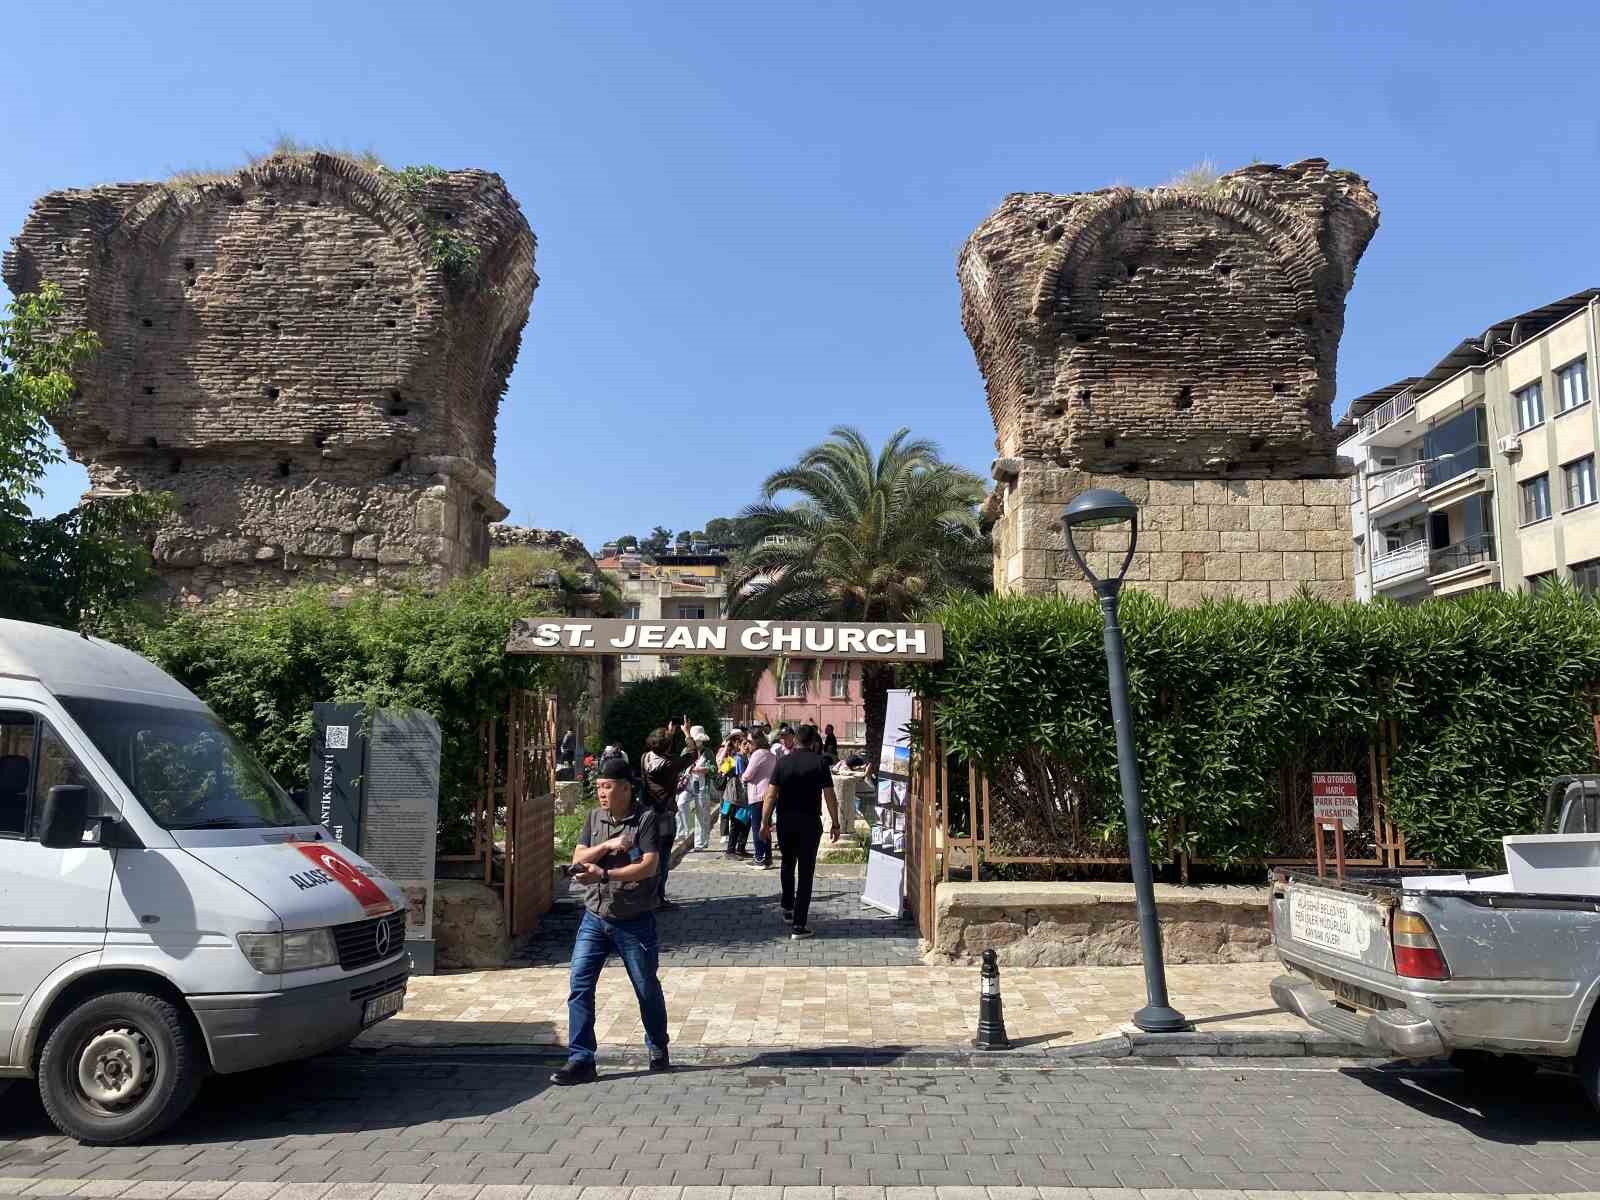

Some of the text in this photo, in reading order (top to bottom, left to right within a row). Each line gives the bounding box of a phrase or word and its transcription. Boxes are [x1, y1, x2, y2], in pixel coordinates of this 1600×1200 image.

[532, 623, 595, 648] ST.
[610, 624, 727, 649] JEAN
[1312, 776, 1326, 784] TUR
[1314, 798, 1333, 806] PARK
